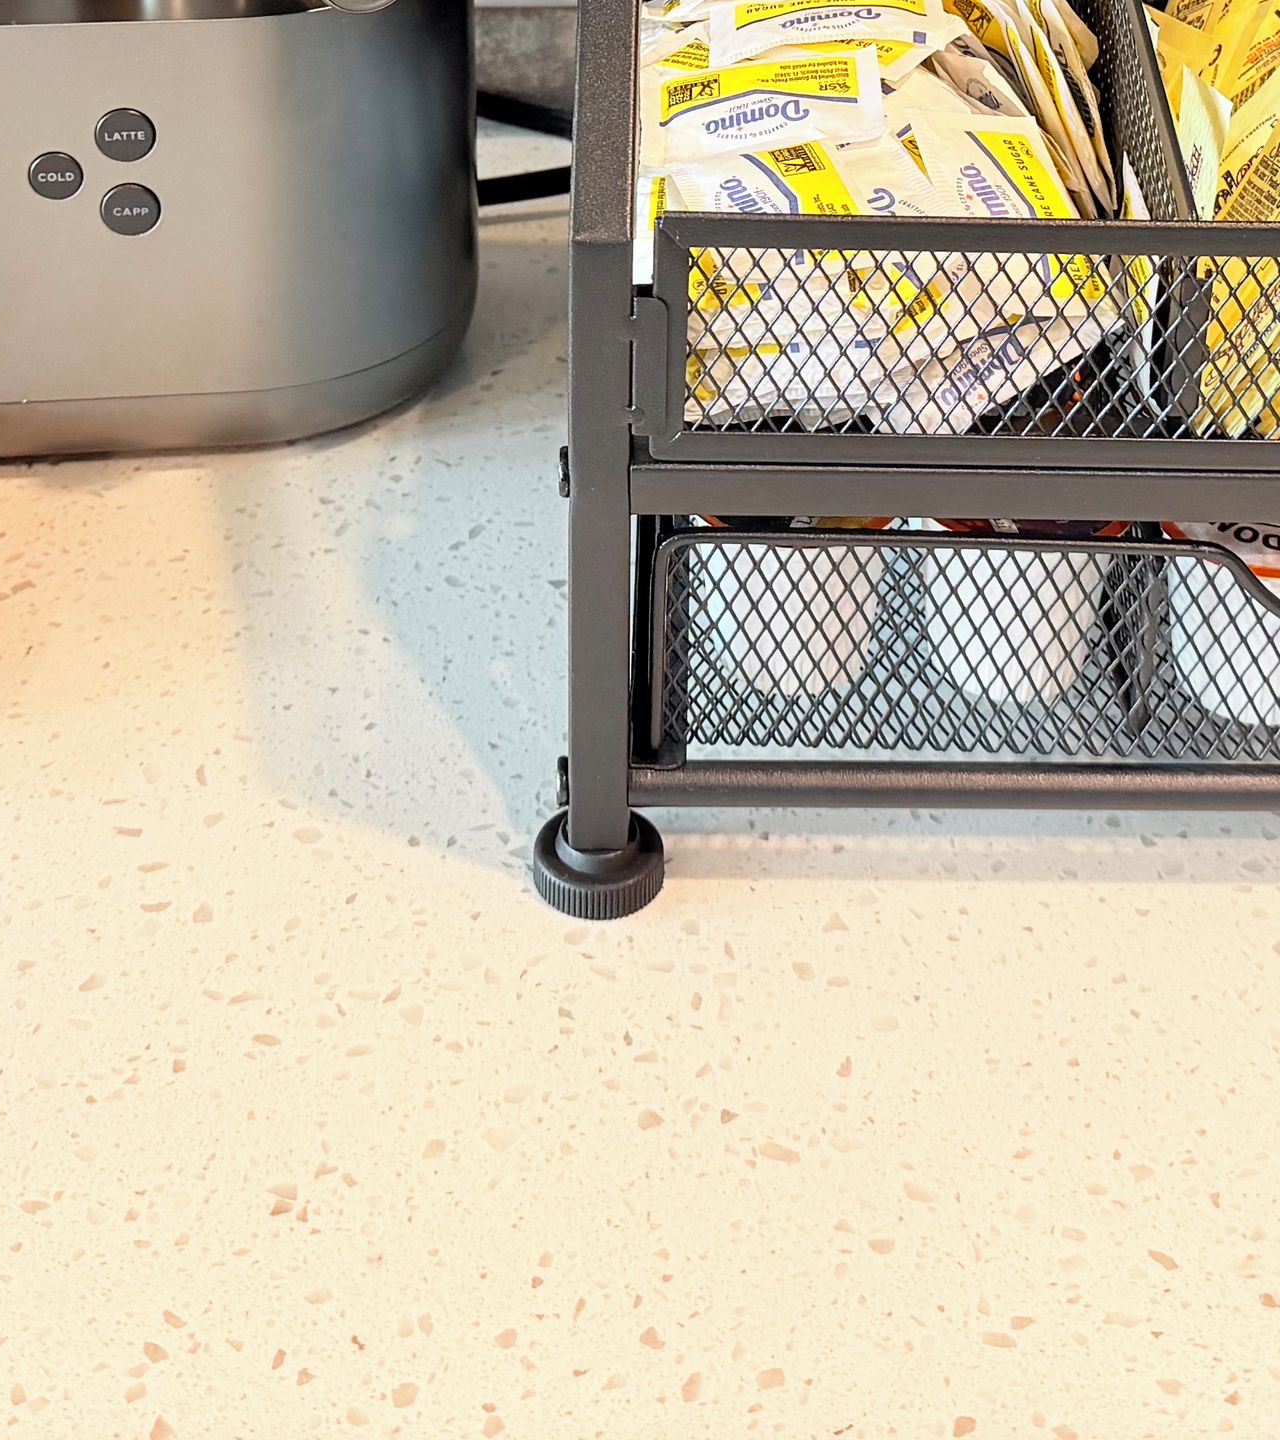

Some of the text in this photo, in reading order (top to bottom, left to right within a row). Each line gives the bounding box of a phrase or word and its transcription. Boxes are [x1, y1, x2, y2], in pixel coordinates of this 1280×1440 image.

[781, 7, 882, 30] Domino
[819, 81, 847, 92] ASR
[704, 98, 810, 136] Domino
[104, 130, 146, 142] LATTE
[37, 171, 75, 182] COLD
[1003, 138, 1029, 172] SUGAR
[1023, 174, 1046, 202] CANE
[959, 164, 1010, 217] mino
[112, 207, 149, 217] CAPP
